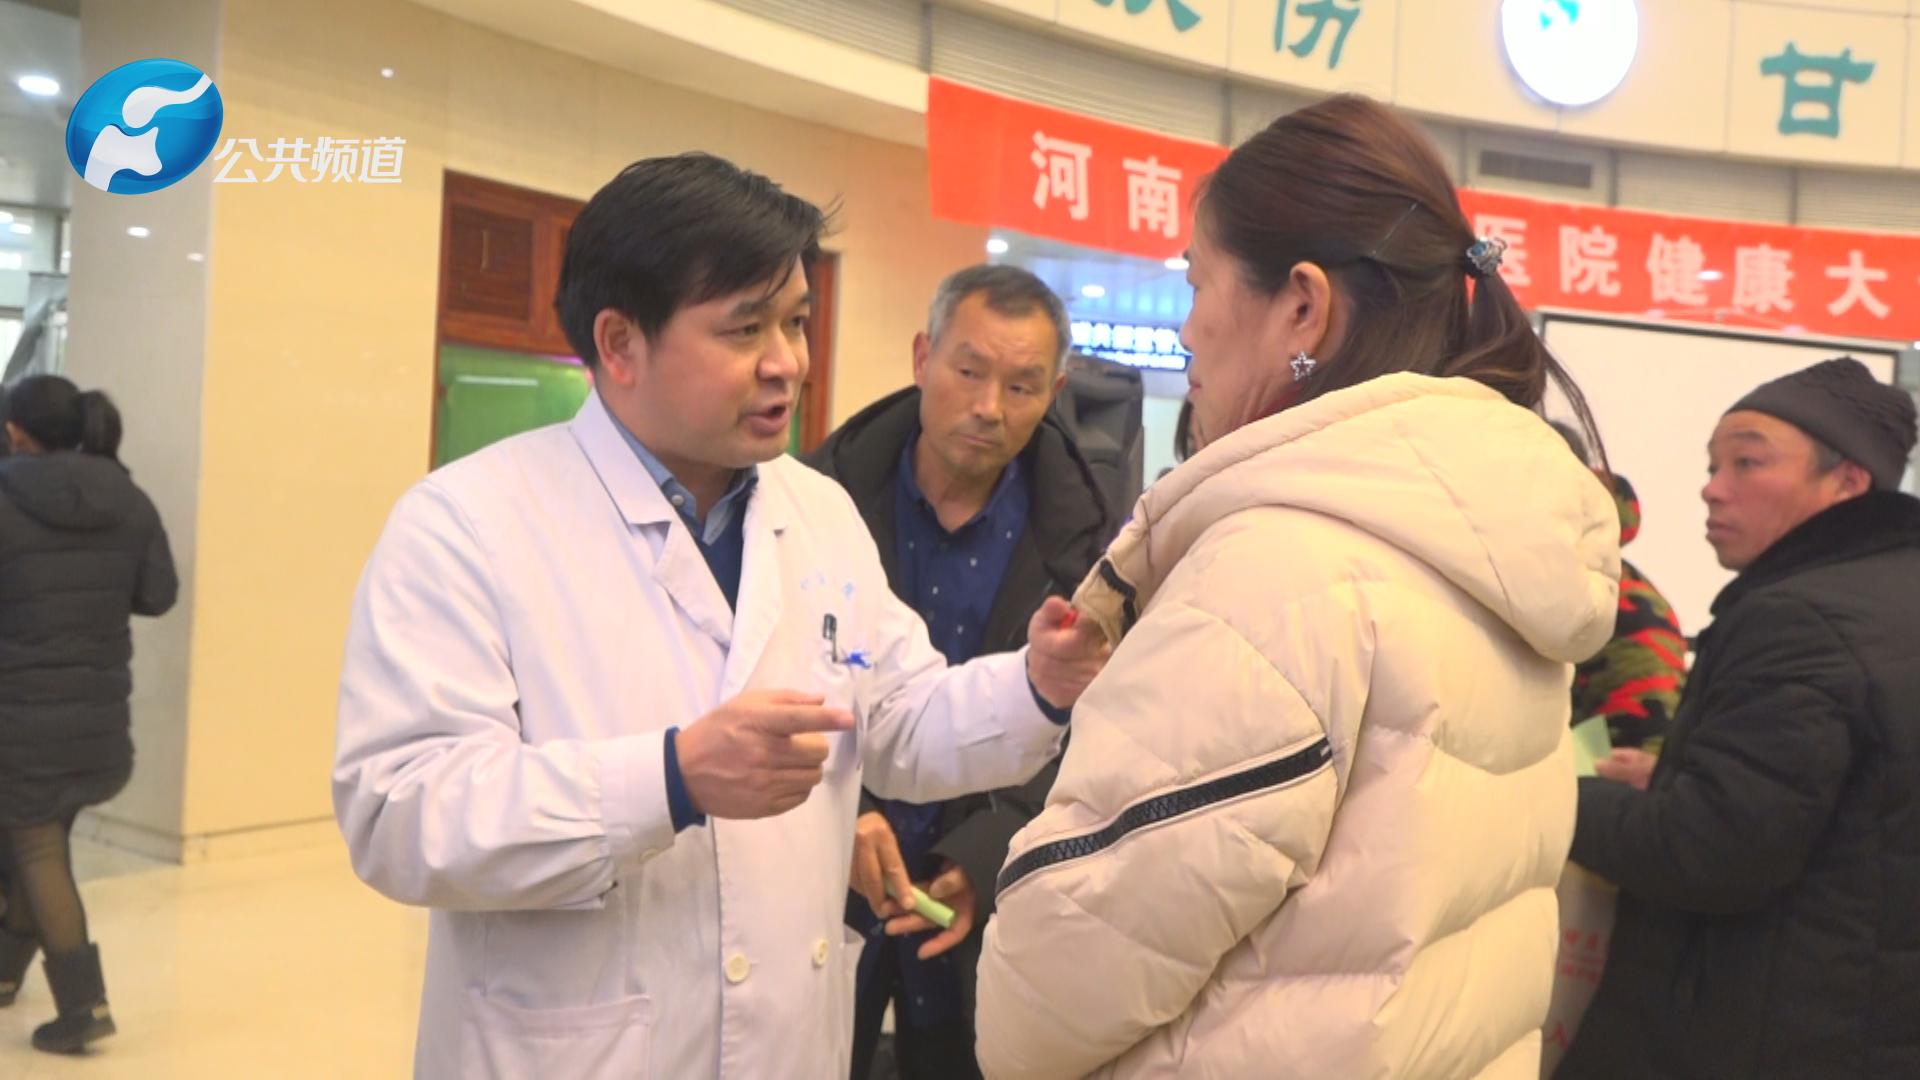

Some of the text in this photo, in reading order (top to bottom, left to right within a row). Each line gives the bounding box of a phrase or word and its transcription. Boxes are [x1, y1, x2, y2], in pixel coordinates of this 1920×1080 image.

[1760, 41, 1875, 139] 甘
[1030, 130, 1920, 319] 河南 医院健康大
